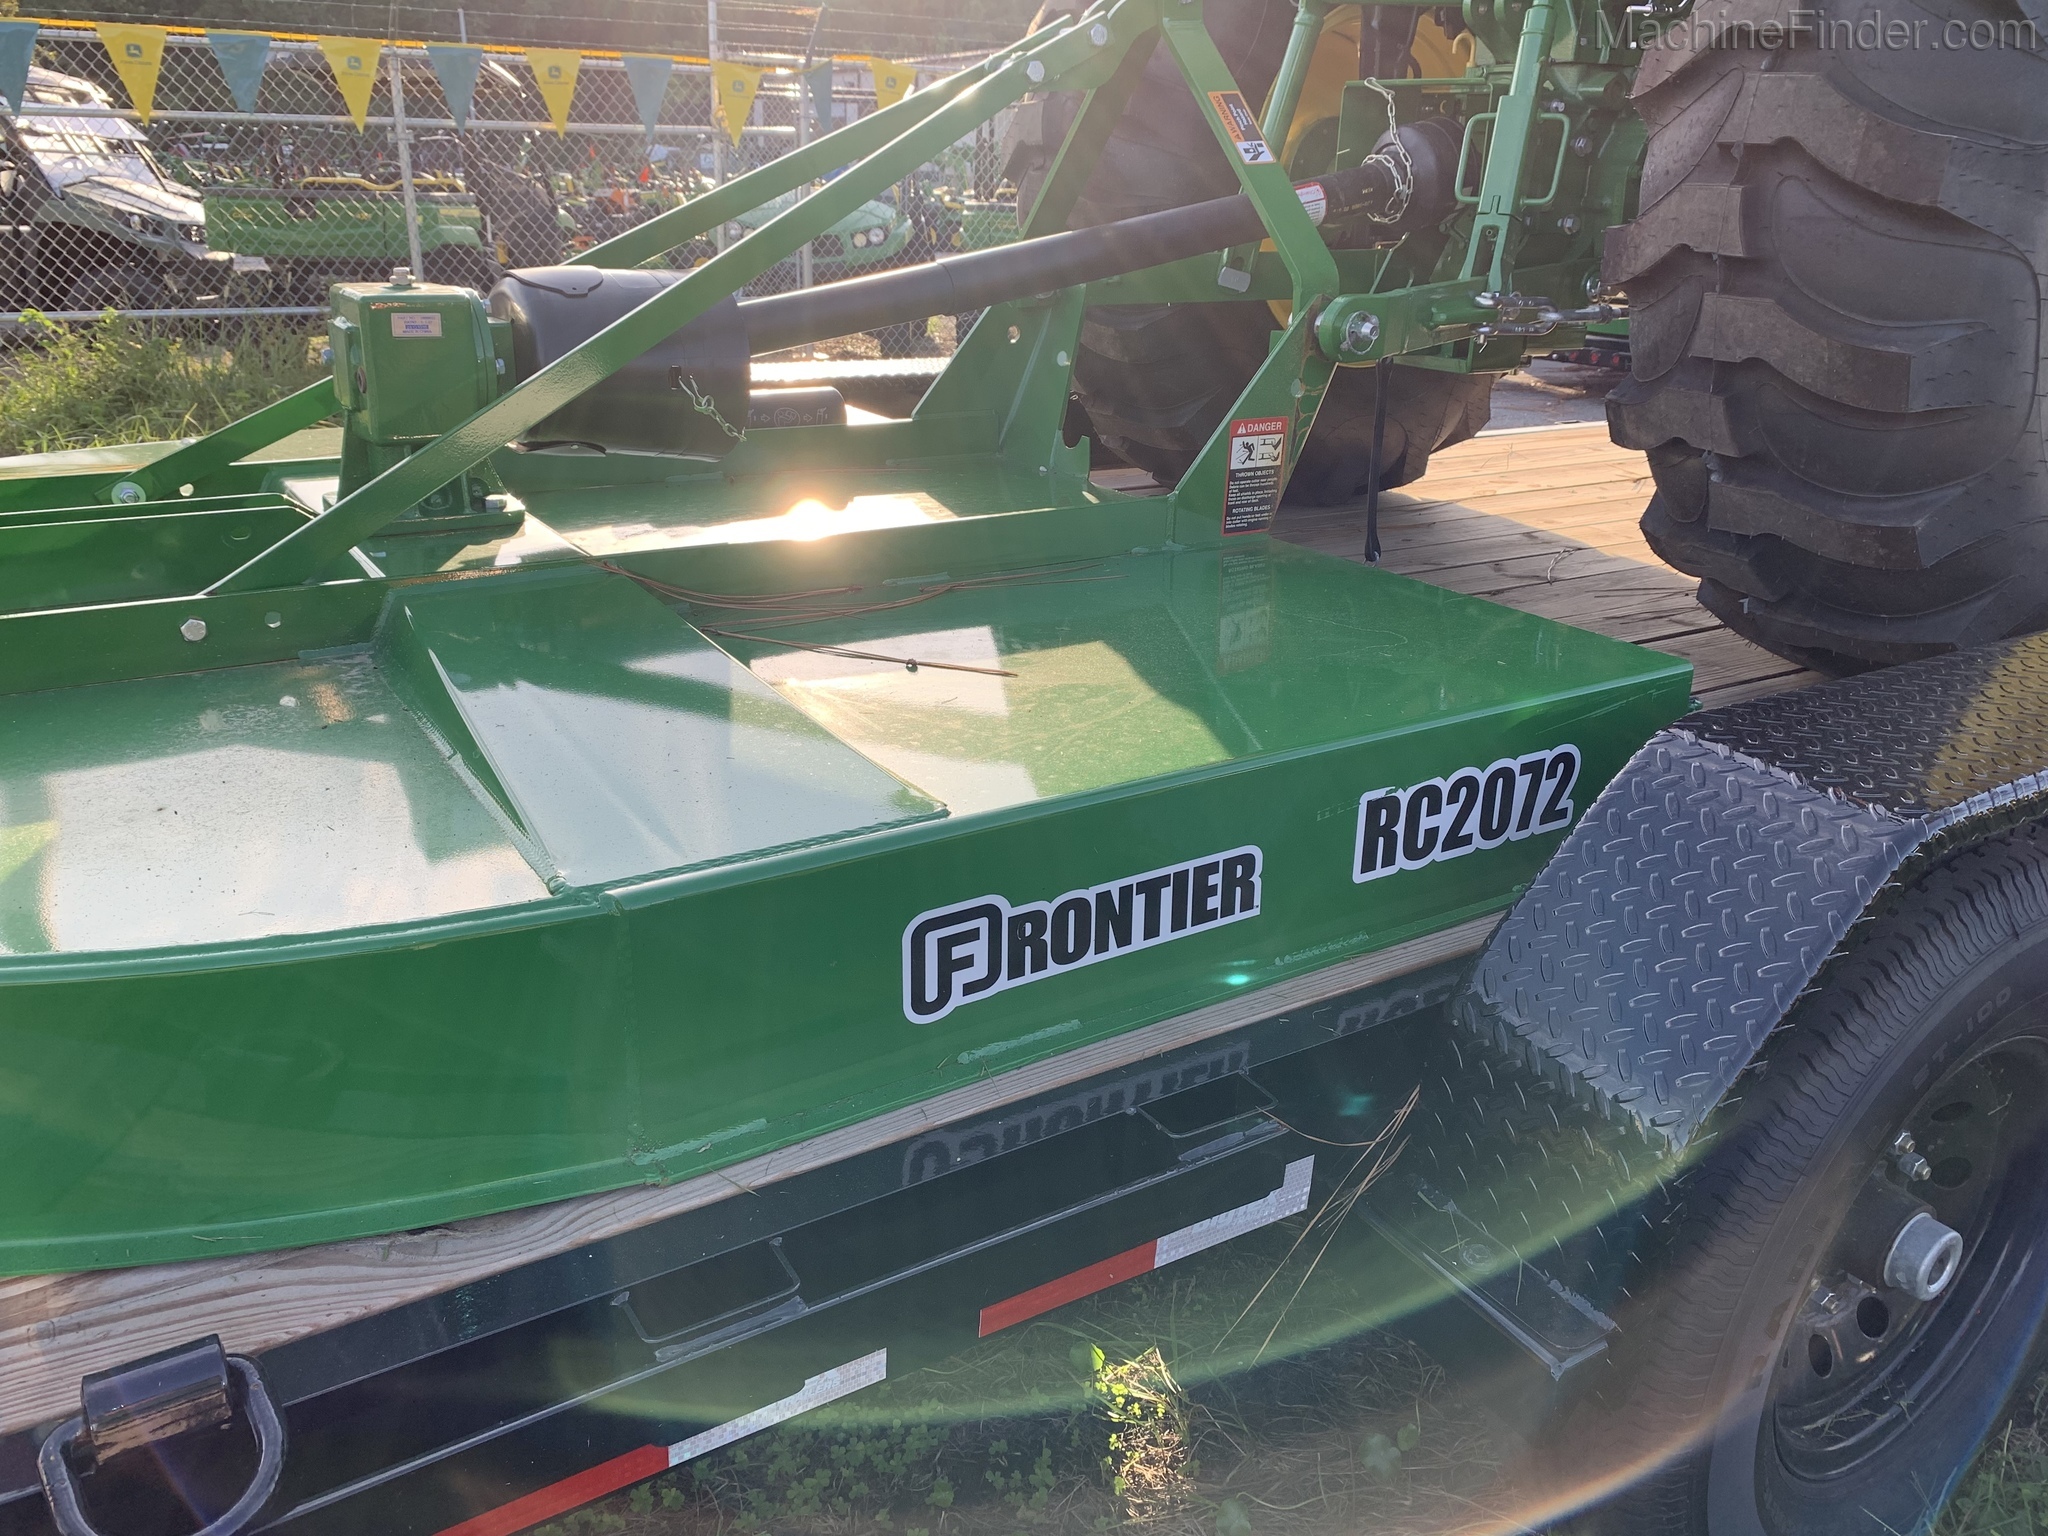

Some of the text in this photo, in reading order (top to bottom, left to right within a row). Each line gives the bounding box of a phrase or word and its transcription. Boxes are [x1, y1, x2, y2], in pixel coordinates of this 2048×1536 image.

[1213, 95, 1238, 134] WARNING
[1247, 421, 1282, 432] DANGER
[1360, 752, 1576, 874] RC2072
[911, 853, 1256, 1015] FRONTIER
